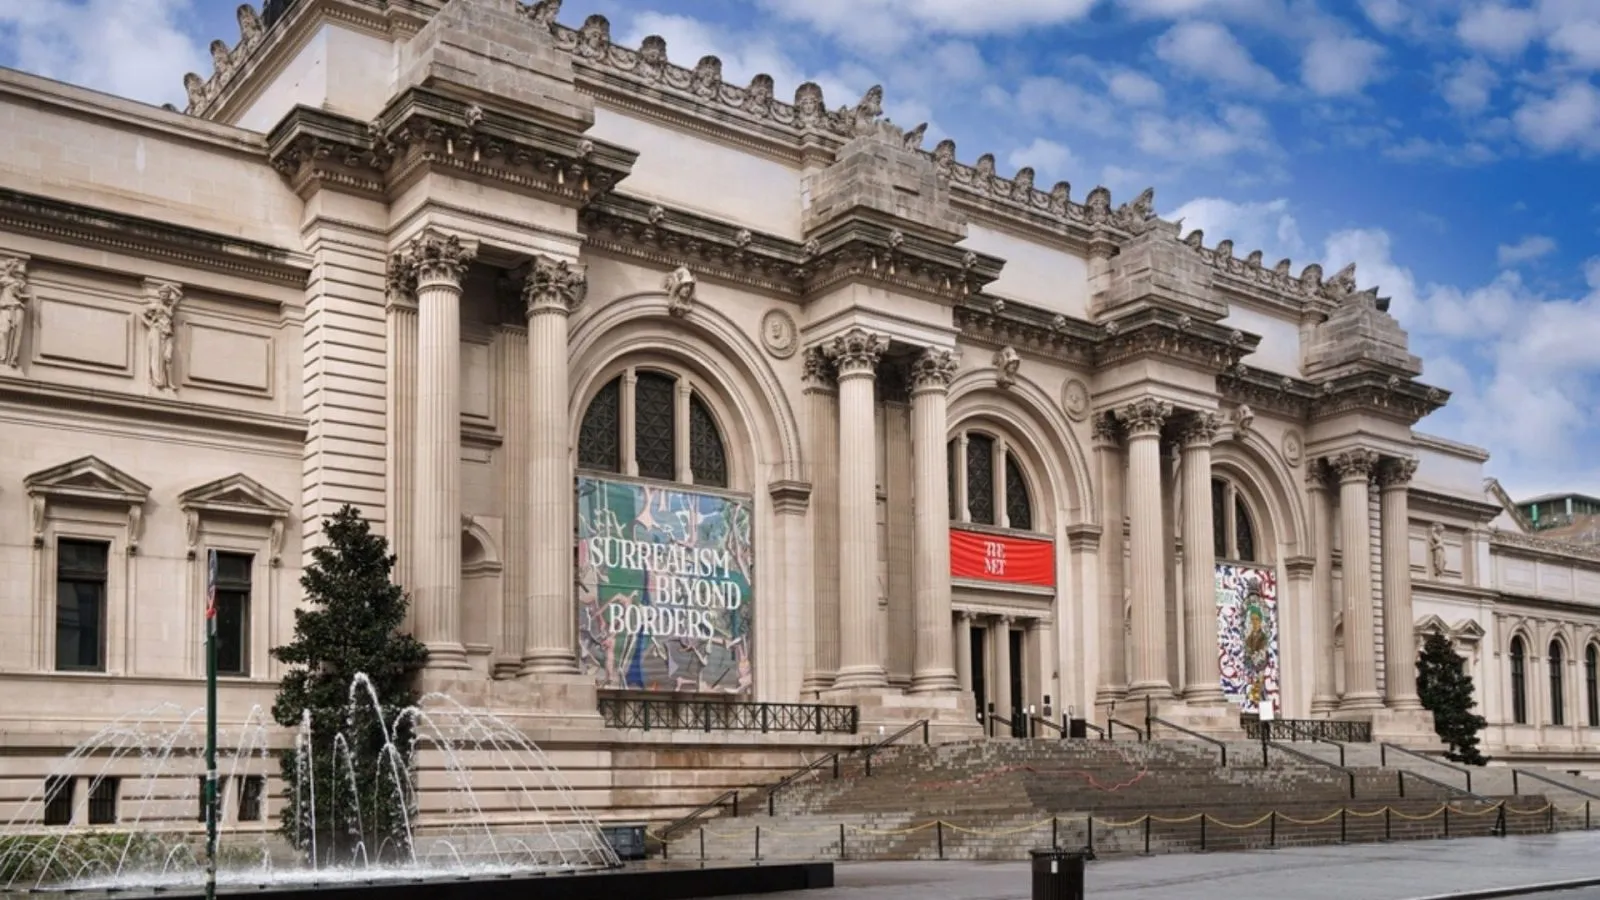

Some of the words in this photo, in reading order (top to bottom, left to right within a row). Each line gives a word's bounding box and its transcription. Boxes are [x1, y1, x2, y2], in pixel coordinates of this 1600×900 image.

[589, 536, 731, 579] SURREALISM
[983, 541, 1006, 559] THE
[983, 557, 1006, 576] MET
[655, 575, 742, 610] BEYOND
[608, 603, 715, 639] BORDERS
